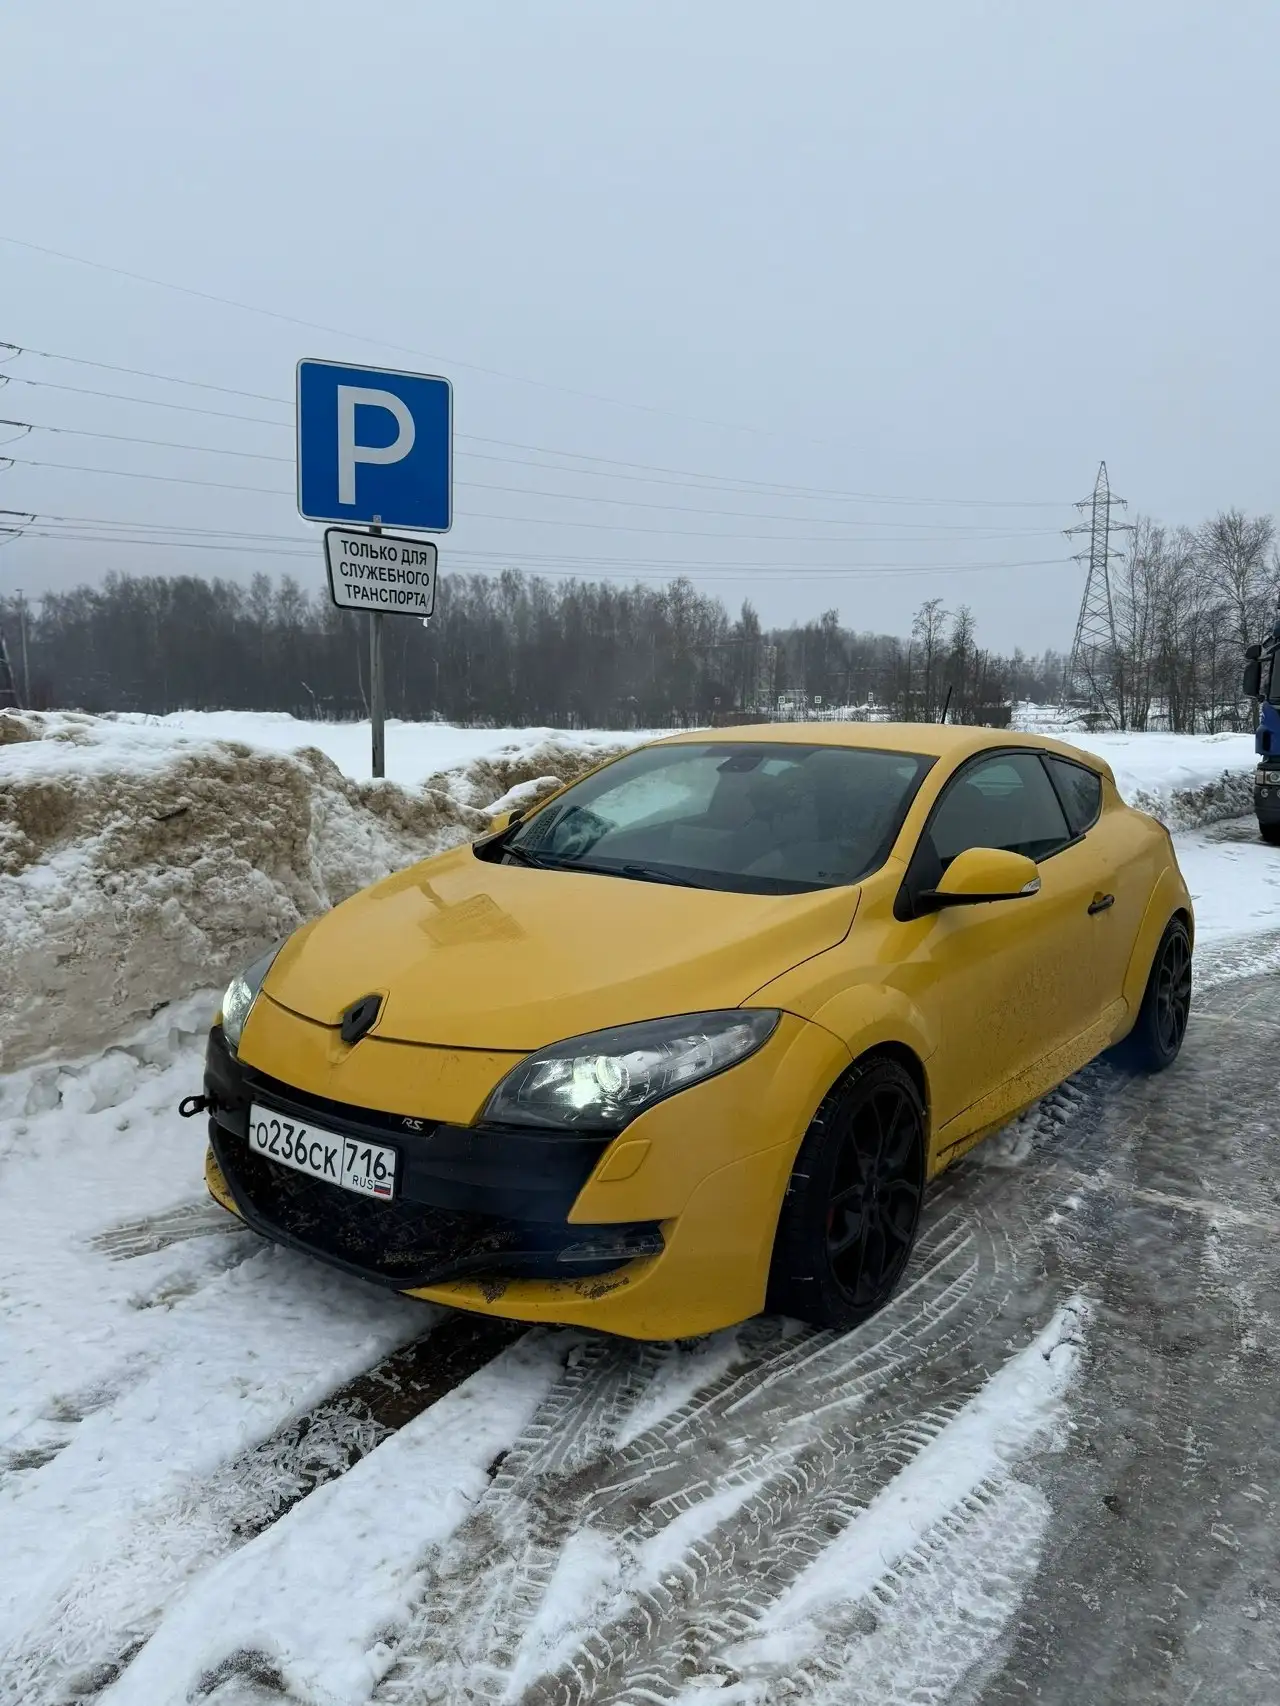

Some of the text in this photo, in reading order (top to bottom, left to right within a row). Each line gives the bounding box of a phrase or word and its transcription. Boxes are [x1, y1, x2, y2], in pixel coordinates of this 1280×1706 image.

[337, 384, 416, 506] P
[340, 540, 427, 566] ТОЛЬКО ДЛЯ
[340, 562, 430, 586] СЛУЖЕБНОГО
[344, 584, 427, 607] ТРАНСПОРТА
[352, 1174, 374, 1190] RUS
